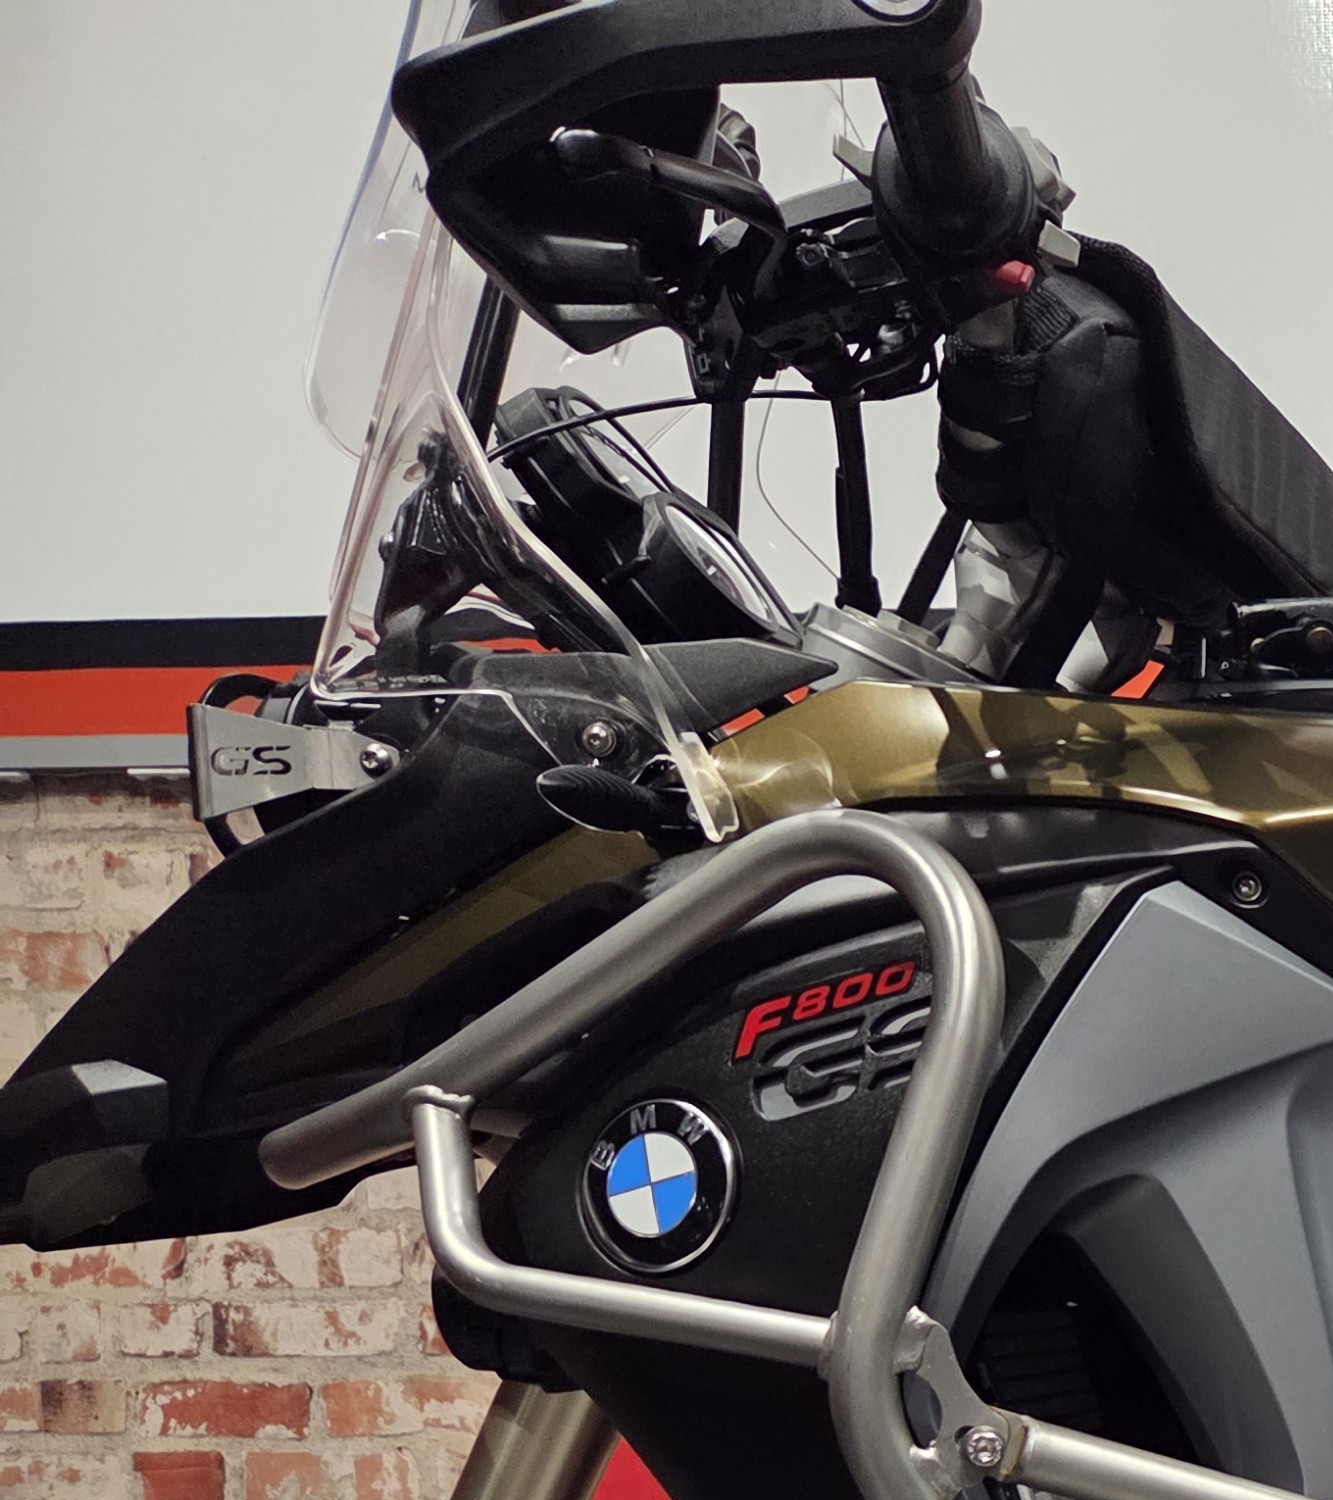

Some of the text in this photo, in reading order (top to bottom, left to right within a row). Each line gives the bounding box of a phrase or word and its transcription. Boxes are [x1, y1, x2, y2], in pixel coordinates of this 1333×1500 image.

[210, 746, 292, 776] GS
[734, 961, 916, 1060] F800
[589, 1103, 708, 1171] BMW
